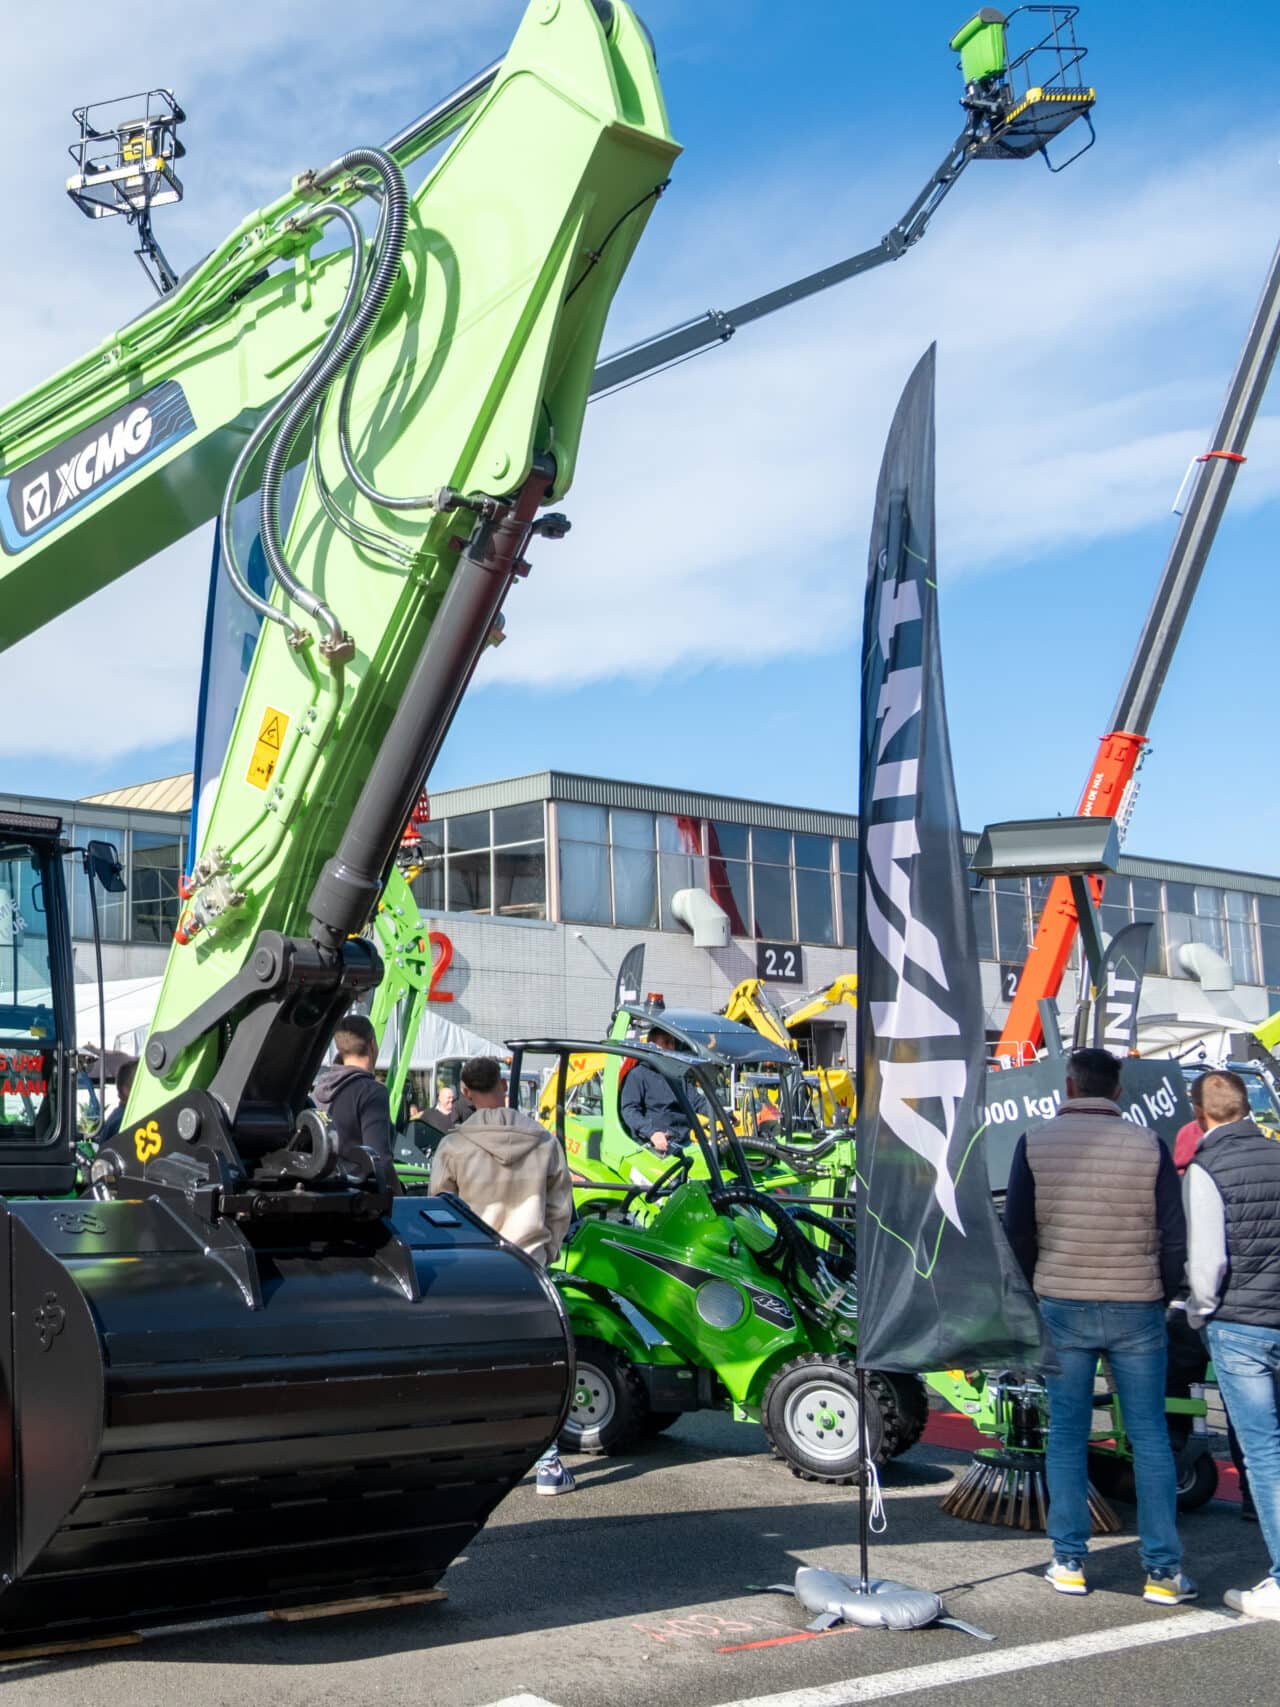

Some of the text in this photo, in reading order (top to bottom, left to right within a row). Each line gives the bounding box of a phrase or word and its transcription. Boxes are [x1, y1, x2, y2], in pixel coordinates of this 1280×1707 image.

[52, 406, 153, 512] XCMG
[865, 578, 966, 1237] AVANT
[427, 931, 455, 1002] 2
[765, 949, 796, 977] 2.2
[12, 1055, 45, 1073] UW
[0, 1079, 48, 1097] AAN!
[1022, 1089, 1062, 1120] kg!
[1142, 1076, 1178, 1121] kg!
